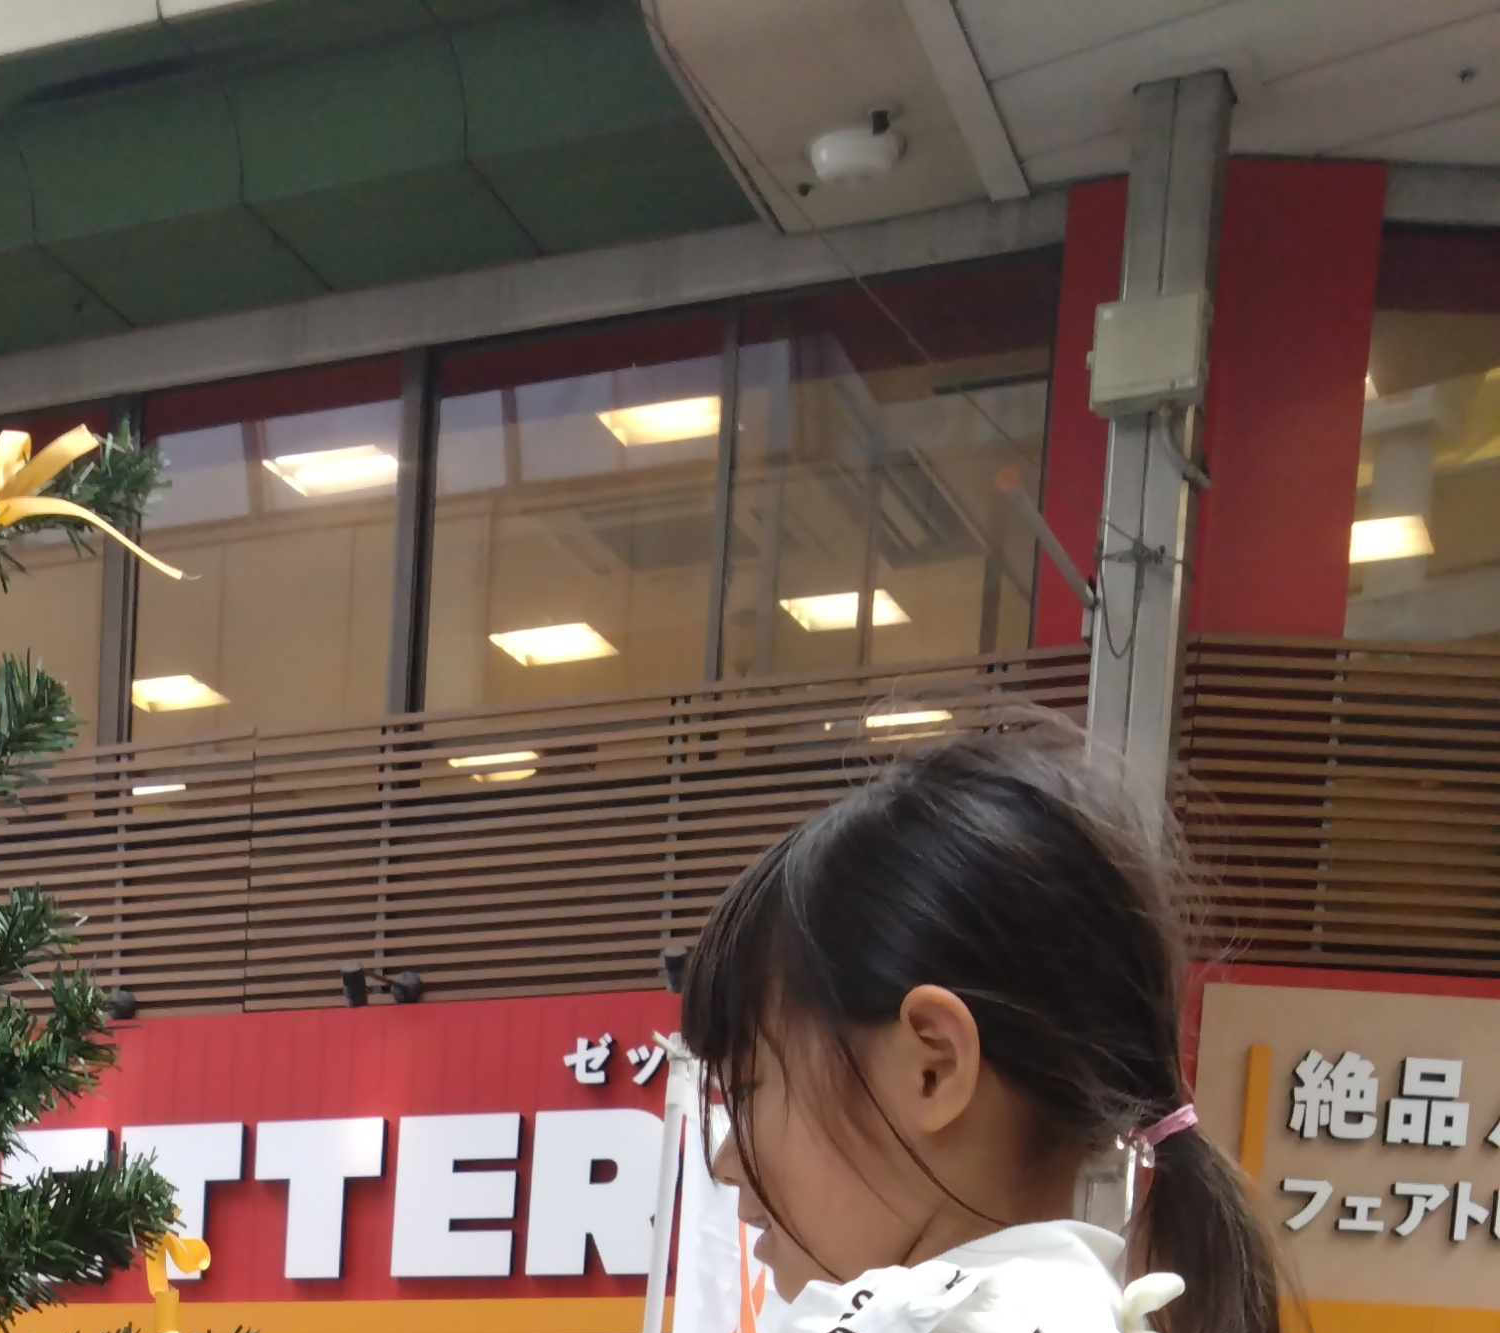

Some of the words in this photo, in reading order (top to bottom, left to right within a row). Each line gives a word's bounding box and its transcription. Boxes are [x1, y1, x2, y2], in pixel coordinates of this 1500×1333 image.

[563, 1032, 668, 1086] ゼッ
[1288, 1049, 1500, 1149] 絶品
[1280, 1177, 1500, 1243] フェアト
